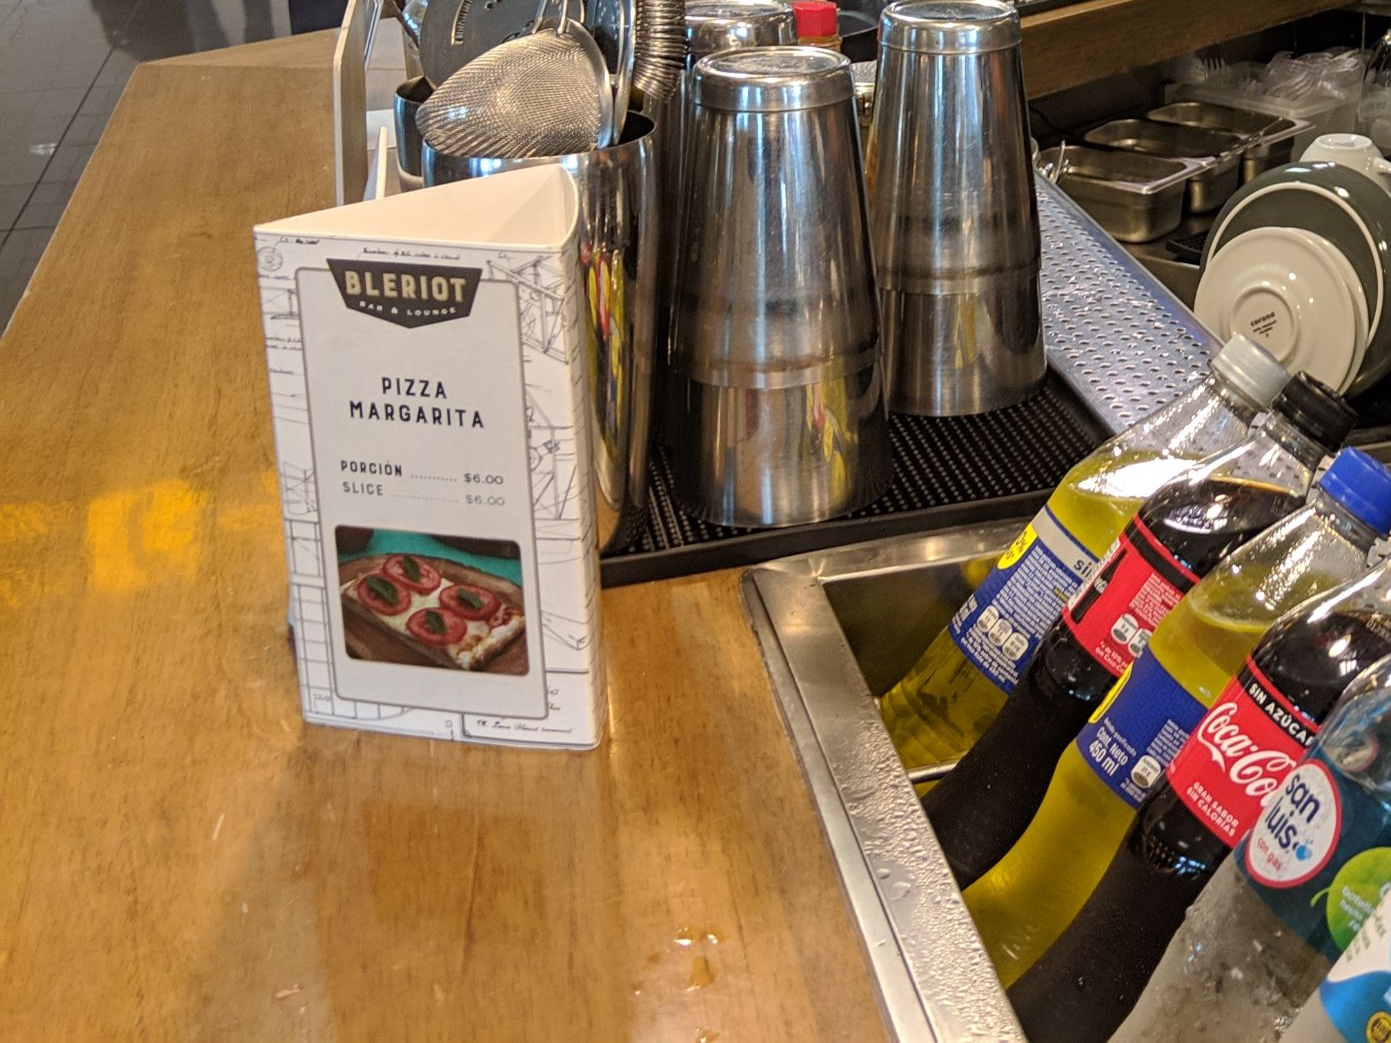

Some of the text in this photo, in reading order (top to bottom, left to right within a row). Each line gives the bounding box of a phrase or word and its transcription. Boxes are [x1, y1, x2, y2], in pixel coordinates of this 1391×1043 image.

[344, 270, 466, 303] BLERIOT
[359, 301, 383, 312] BAR
[407, 307, 457, 316] LOUNGE
[1250, 311, 1276, 327] corona
[382, 376, 448, 399] PIZZA
[349, 401, 485, 429] MARGARITA
[340, 460, 504, 486] PORCIÓN $6.00
[343, 481, 506, 508] SLICE $6.00
[1249, 683, 1267, 705] SIN
[1089, 739, 1120, 777] 450 ml
[1096, 726, 1129, 766] Cont. Neto
[1197, 702, 1298, 808] Coca-Co
[1186, 787, 1198, 802] SIN
[1193, 781, 1239, 827] GRAN SABOR
[1285, 773, 1320, 824] san
[1264, 795, 1298, 849] luis
